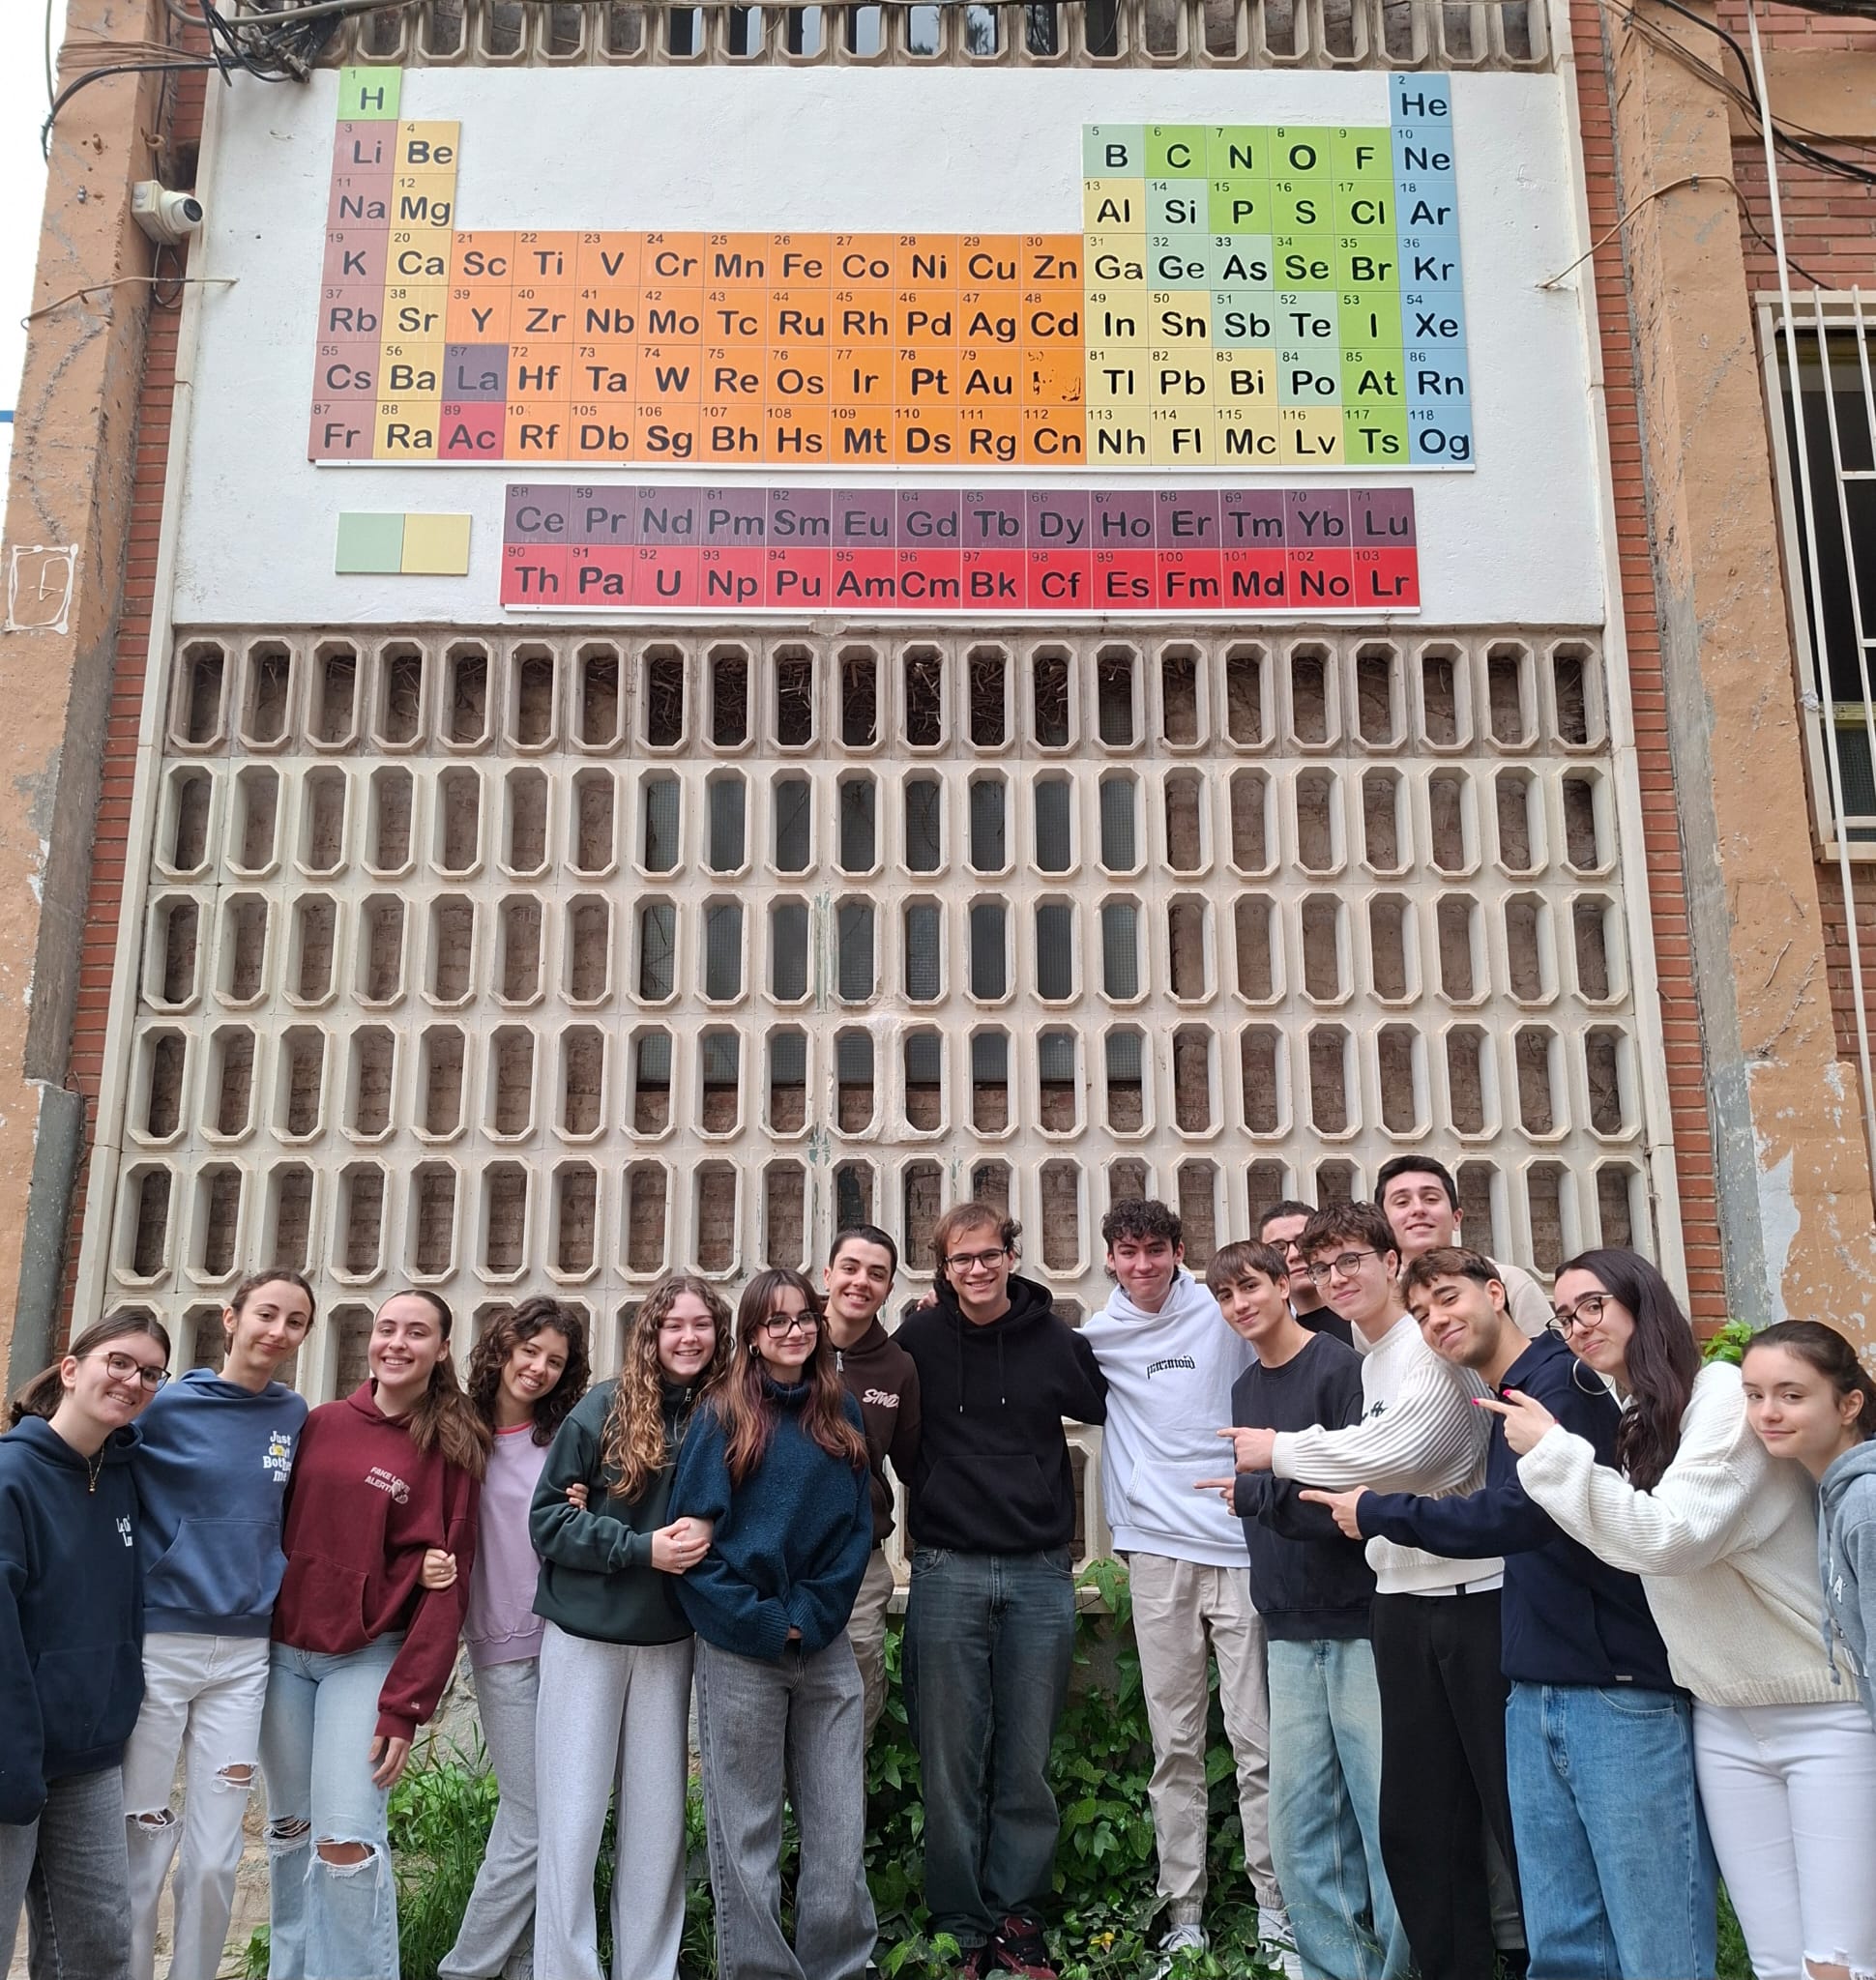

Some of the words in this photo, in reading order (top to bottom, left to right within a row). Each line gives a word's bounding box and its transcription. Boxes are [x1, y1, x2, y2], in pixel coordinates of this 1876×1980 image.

[350, 70, 356, 79] 1
[1398, 75, 1405, 85] 2
[361, 87, 384, 110] H
[1402, 93, 1447, 117] He
[407, 123, 415, 132] 4
[1216, 128, 1223, 138] 7
[354, 140, 381, 163] Li
[408, 140, 453, 164] Be
[1106, 144, 1128, 167] B
[1167, 144, 1190, 168] C
[1230, 145, 1252, 169] N
[1289, 145, 1316, 170] O
[1357, 147, 1374, 170] F
[1405, 147, 1451, 170] Ne
[399, 178, 415, 188] 12
[1276, 182, 1292, 192] 16
[339, 195, 385, 219] Na
[400, 196, 451, 226] Mg
[1097, 199, 1129, 222] Al
[1165, 199, 1195, 224] Si
[1233, 200, 1253, 224] P
[1296, 200, 1316, 224] S
[1351, 200, 1385, 224] Cl
[1410, 200, 1451, 225] Ar
[395, 233, 410, 243] 20
[521, 232, 538, 243] 22
[647, 233, 664, 244] 24
[900, 235, 916, 246] 28
[1216, 237, 1231, 247] 33
[1404, 238, 1420, 248] 36
[343, 250, 366, 276] K
[398, 250, 444, 276] Ca
[463, 251, 506, 277] Sc
[533, 251, 563, 276] Ti
[601, 251, 624, 277] V
[656, 252, 697, 277] Cr
[716, 253, 764, 277] Mn
[783, 253, 822, 278] Fe
[843, 254, 889, 278] Co
[913, 254, 947, 279] Ni
[969, 253, 1015, 279] Cu
[1033, 255, 1077, 278] Zn
[1095, 255, 1143, 279] Ga
[1158, 255, 1204, 279] Ge
[1223, 254, 1267, 280] As
[1285, 255, 1329, 279] Se
[1352, 256, 1392, 281] Br
[1415, 256, 1454, 281] Kr
[645, 290, 661, 301] 42
[835, 291, 853, 302] 45
[1154, 293, 1169, 303] 50
[1407, 295, 1422, 305] 54
[330, 307, 377, 332] Rb
[398, 307, 438, 333] Sr
[471, 307, 493, 333] Y
[525, 308, 567, 333] Zr
[587, 308, 634, 334] Nb
[649, 309, 699, 335] Mo
[717, 310, 757, 335] Tc
[779, 310, 824, 336] Ru
[843, 310, 888, 335] Rh
[908, 311, 951, 335] Pd
[969, 312, 1015, 343] Ag
[1031, 312, 1078, 336] Cd
[1105, 312, 1134, 336] In
[1161, 311, 1206, 337] Sn
[1225, 312, 1270, 337] Sb
[1289, 313, 1331, 337] Te
[1370, 313, 1377, 337] I
[1416, 313, 1458, 337] Xe
[645, 347, 660, 358] 74
[900, 349, 916, 361] 78
[1216, 351, 1233, 362] 83
[1410, 352, 1426, 362] 86
[327, 364, 371, 390] Cs
[390, 364, 435, 391] Ba
[458, 365, 498, 391] La
[519, 365, 561, 391] Hf
[586, 366, 627, 393] Ta
[656, 366, 689, 392] W
[715, 367, 759, 393] Re
[777, 369, 824, 394] Os
[854, 368, 879, 393] Ir
[912, 368, 949, 395] Pt
[965, 369, 1011, 394] Au
[1102, 369, 1133, 394] Tl
[1160, 370, 1205, 394] Pb
[1231, 369, 1264, 394] Bi
[1292, 370, 1334, 395] Po
[1358, 370, 1398, 395] At
[1418, 371, 1464, 394] Rn
[637, 406, 662, 417] 106
[832, 408, 856, 419] 109
[1410, 410, 1434, 421] 118
[324, 423, 361, 449] Fr
[387, 423, 432, 449] Ra
[448, 423, 495, 450] Ac
[520, 424, 560, 450] Rf
[580, 424, 629, 451] Db
[647, 425, 692, 457] Sg
[713, 426, 758, 451] Bh
[777, 427, 822, 452] Hs
[844, 427, 887, 453] Mt
[907, 427, 951, 453] Ds
[970, 429, 1015, 461] Rg
[1034, 428, 1081, 453] Cn
[1099, 428, 1145, 454] Nh
[1173, 428, 1201, 453] Fl
[1226, 428, 1275, 454] Mc
[1296, 429, 1335, 454] Lv
[1359, 428, 1399, 453] Ts
[1420, 428, 1470, 460] Og
[516, 507, 564, 533] Ce
[586, 508, 627, 534] Pr
[643, 508, 692, 534] Nd
[709, 510, 764, 536] Pm
[774, 510, 829, 536] Sm
[845, 511, 888, 537] Eu
[907, 510, 956, 537] Gd
[973, 510, 1019, 538] Tb
[1041, 512, 1084, 544] Dy
[1102, 511, 1151, 538] Ho
[1172, 510, 1212, 537] Er
[1228, 511, 1282, 538] Tm
[1298, 510, 1343, 537] Yb
[1366, 510, 1408, 536] Lu
[639, 548, 657, 560] 92
[514, 567, 558, 593] Th
[579, 567, 624, 595] Pa
[657, 569, 681, 597] U
[709, 569, 757, 603] Np
[777, 570, 820, 597] Pu
[836, 570, 895, 597] Am
[901, 571, 959, 597] Cm
[971, 571, 1016, 597] Bk
[1041, 571, 1081, 597] Cf
[1107, 571, 1149, 597] Es
[1167, 572, 1218, 597] Fm
[1233, 571, 1284, 597] Md
[1301, 570, 1349, 597] No
[1372, 570, 1409, 596] Lr
[1147, 1355, 1196, 1380] paranoid
[270, 1431, 292, 1446] Just
[370, 1466, 393, 1480] FAKE
